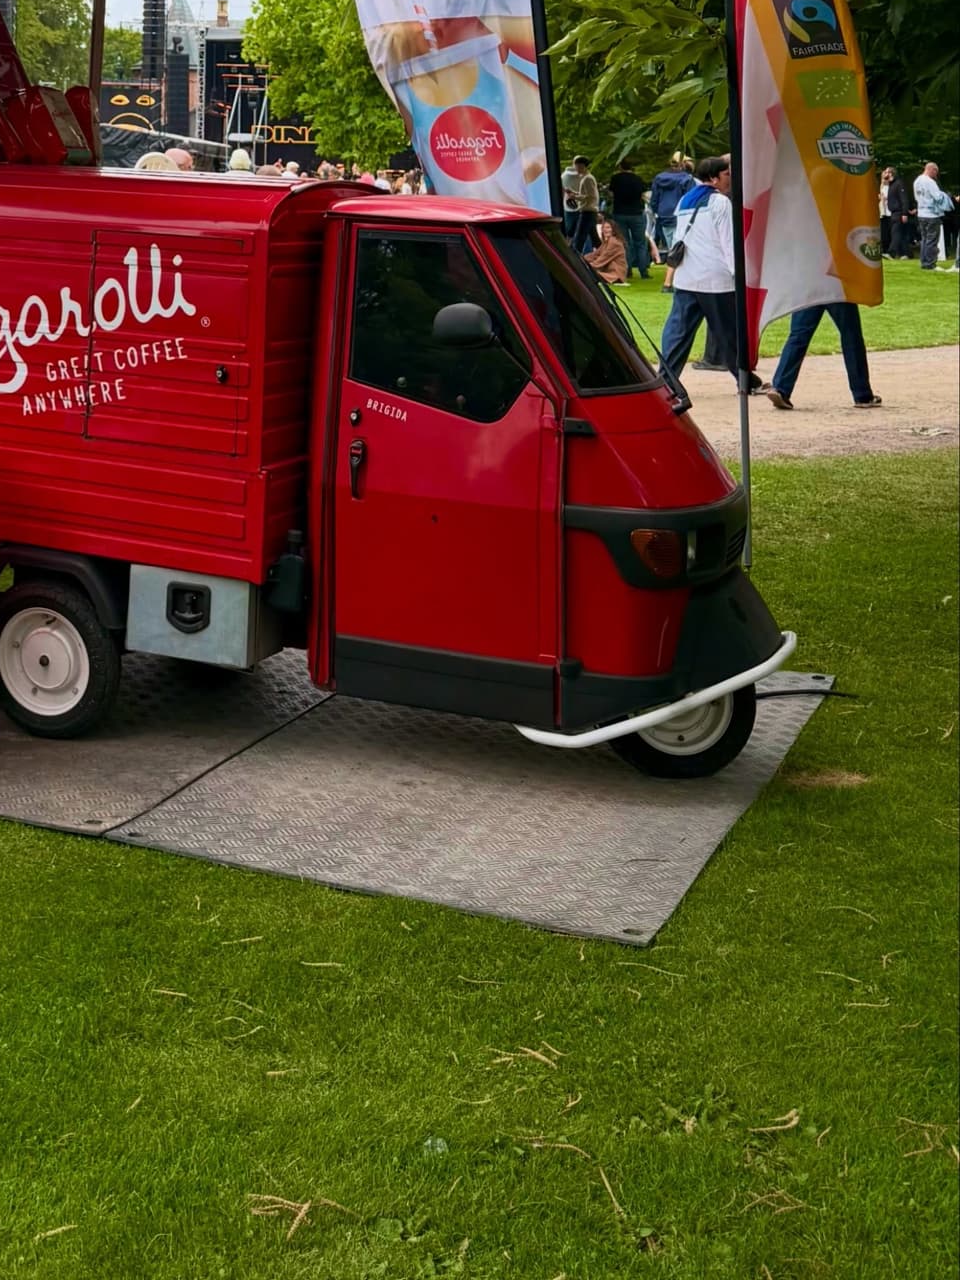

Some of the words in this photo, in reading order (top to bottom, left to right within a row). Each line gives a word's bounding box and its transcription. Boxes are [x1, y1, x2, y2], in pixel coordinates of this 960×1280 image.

[792, 41, 847, 57] FAIRTRADE
[251, 124, 322, 144] DIN
[820, 140, 874, 157] LIFEGATE
[114, 337, 188, 370] COFFEE
[22, 378, 127, 416] ANYWHERE
[366, 398, 408, 422] BRIGIDA
